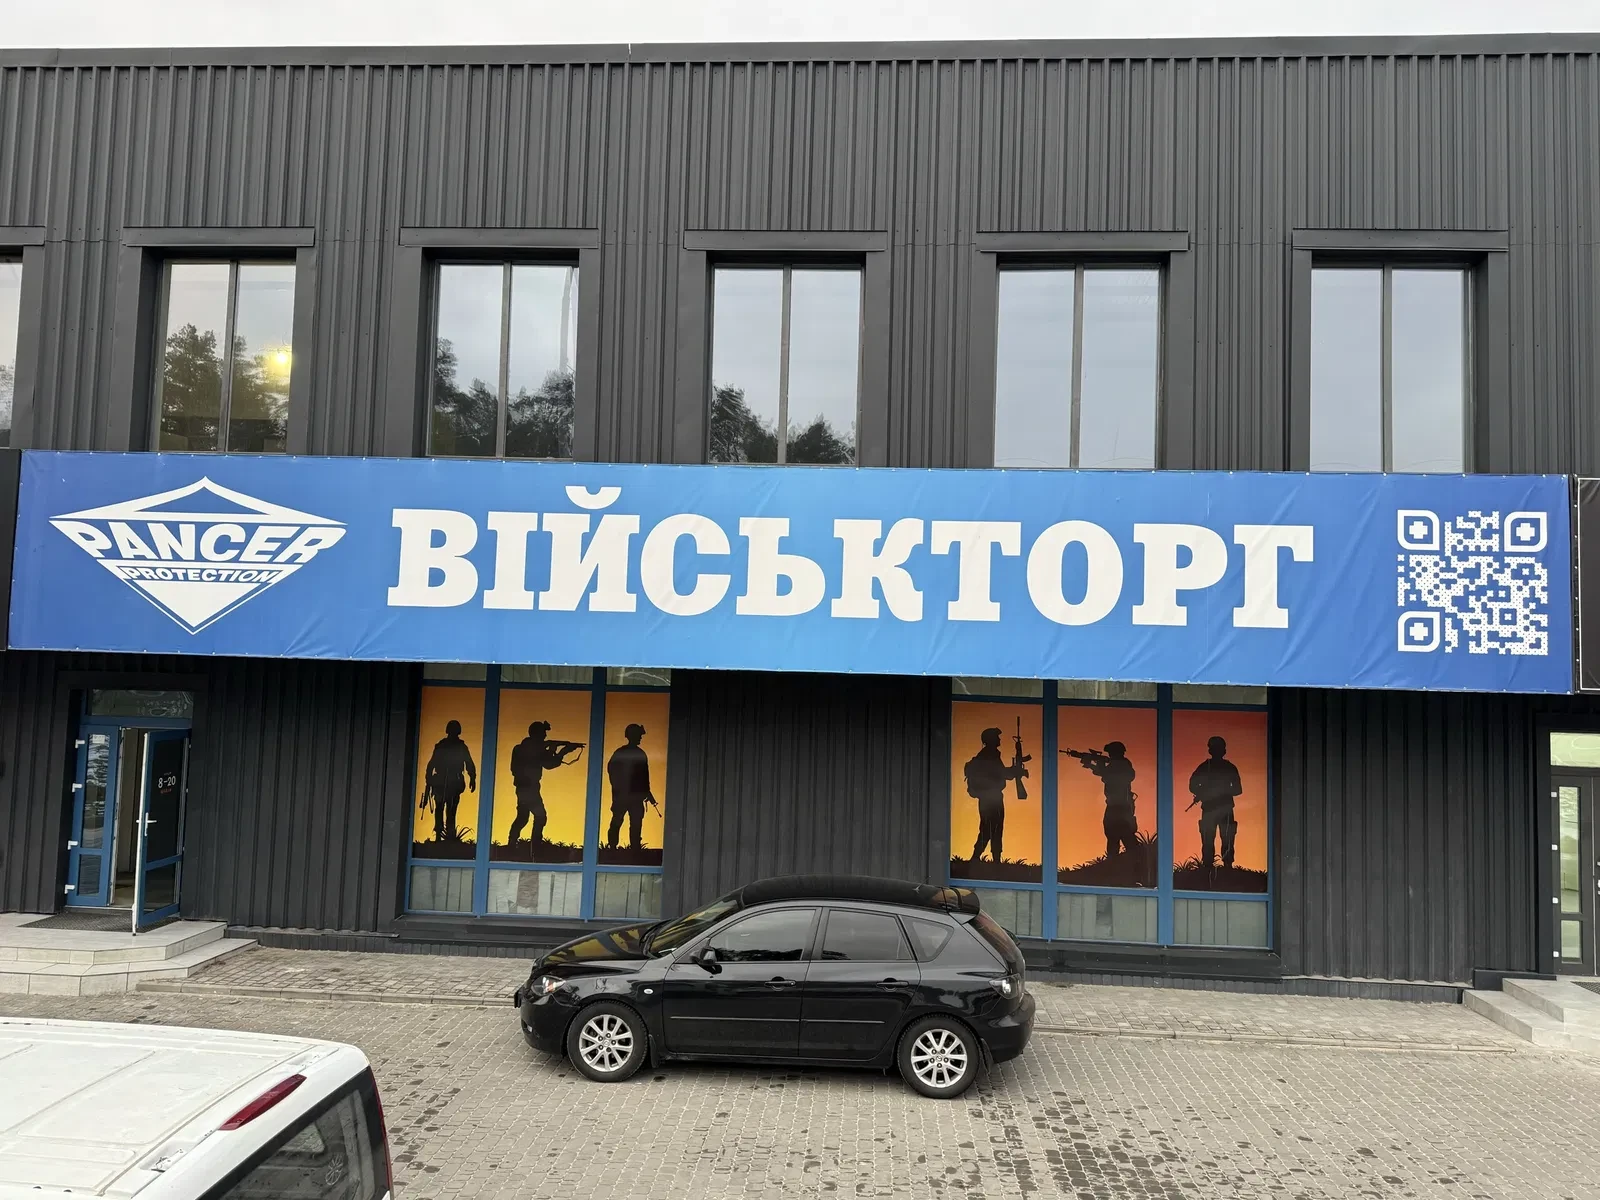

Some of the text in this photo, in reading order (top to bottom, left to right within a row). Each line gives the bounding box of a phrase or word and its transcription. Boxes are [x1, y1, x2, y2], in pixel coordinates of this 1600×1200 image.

[49, 520, 348, 565] PANCER
[387, 486, 1314, 629] ВІЙСЬКТОРГ
[119, 566, 280, 584] PROTECTION
